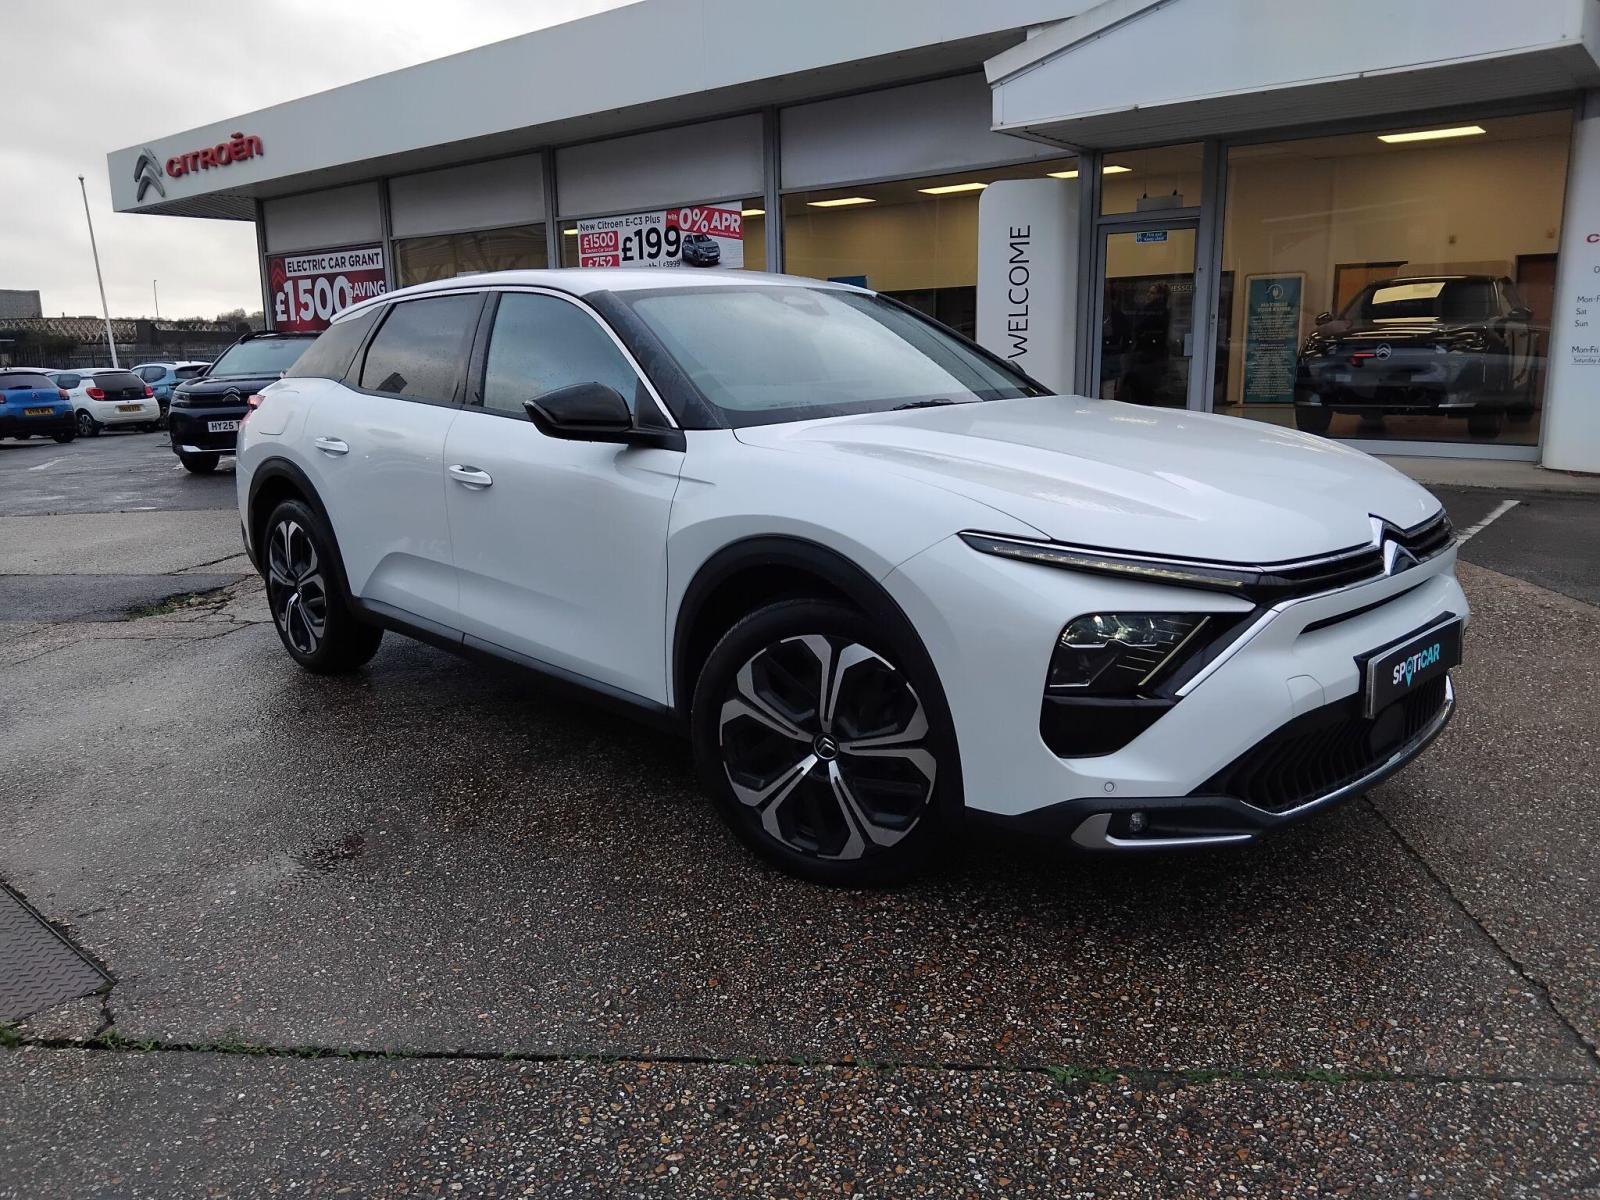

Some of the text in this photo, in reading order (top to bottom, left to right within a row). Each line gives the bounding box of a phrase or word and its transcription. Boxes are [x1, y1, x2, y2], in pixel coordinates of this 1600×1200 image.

[580, 214, 661, 232] New Citroen E-C3 Plus
[678, 208, 709, 233] 0%
[709, 211, 741, 232] APR
[583, 232, 615, 248] £1500
[622, 225, 681, 261] £199
[287, 252, 380, 273] ELECTRIC CAR GRANT
[275, 275, 352, 324] £1,500
[1008, 225, 1030, 358] WELCOME
[1576, 307, 1587, 315] Sat
[1575, 319, 1589, 327] Sun
[1571, 345, 1599, 353] Mon-Fri
[211, 421, 234, 431] HY25
